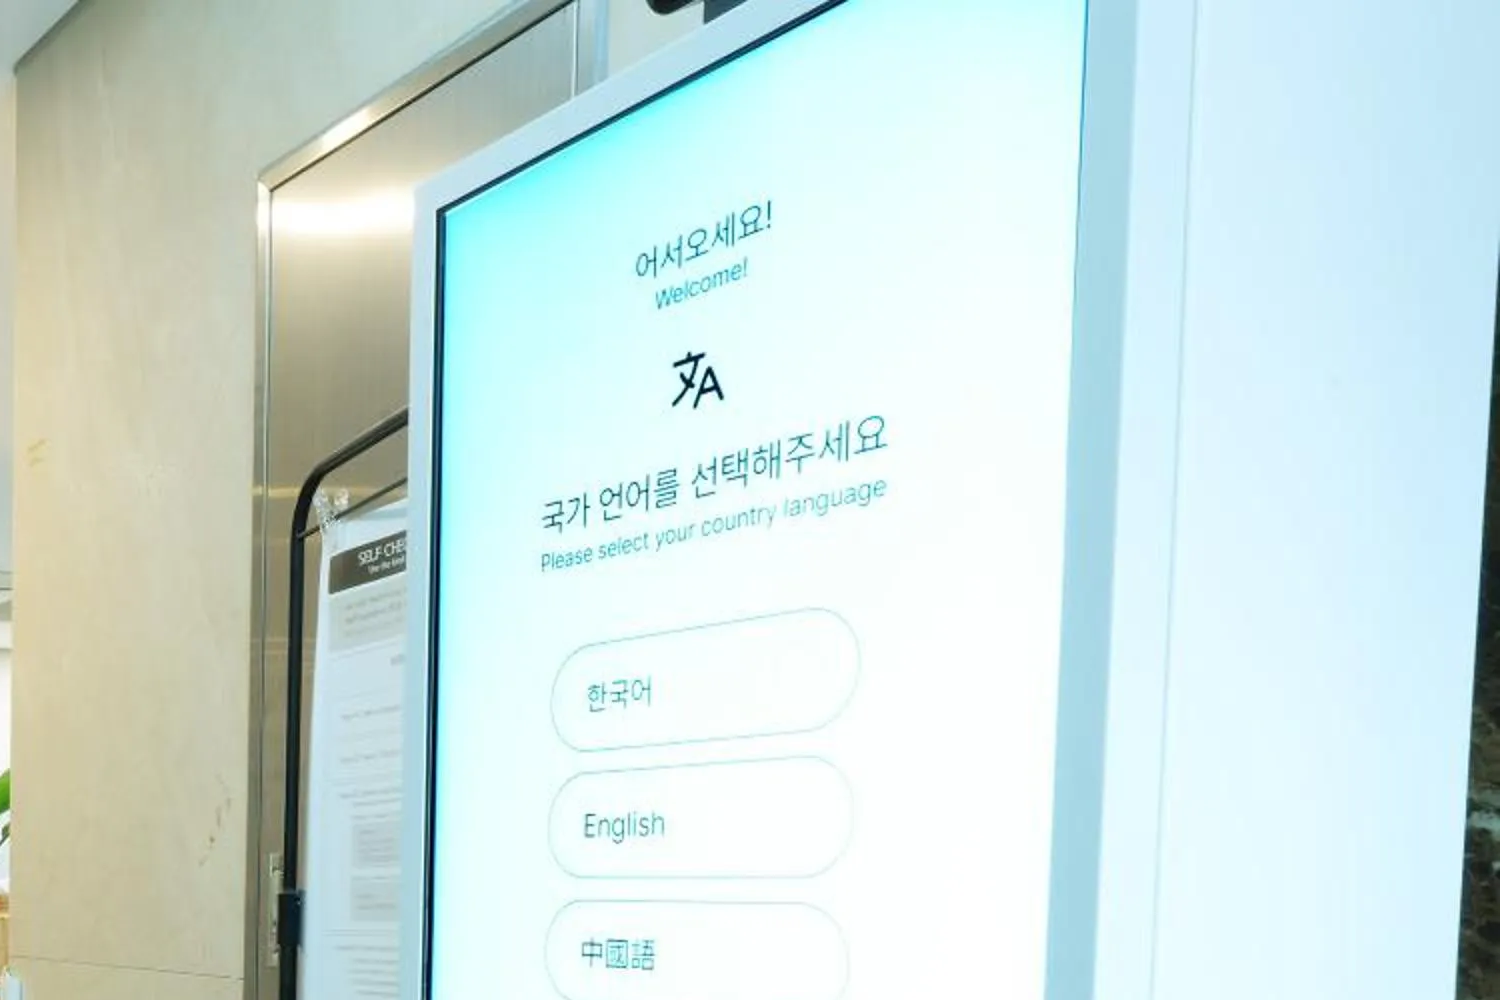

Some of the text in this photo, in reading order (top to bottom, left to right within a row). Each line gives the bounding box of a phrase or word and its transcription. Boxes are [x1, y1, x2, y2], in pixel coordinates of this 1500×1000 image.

[635, 199, 772, 279] 어서오세요!
[655, 255, 749, 310] Welcome!
[541, 414, 889, 534] 국가 언어를 선택해주세요
[540, 477, 889, 573] Please select your country language
[586, 675, 653, 713] 한국어
[583, 810, 667, 845] English
[580, 936, 657, 972] 中國語
